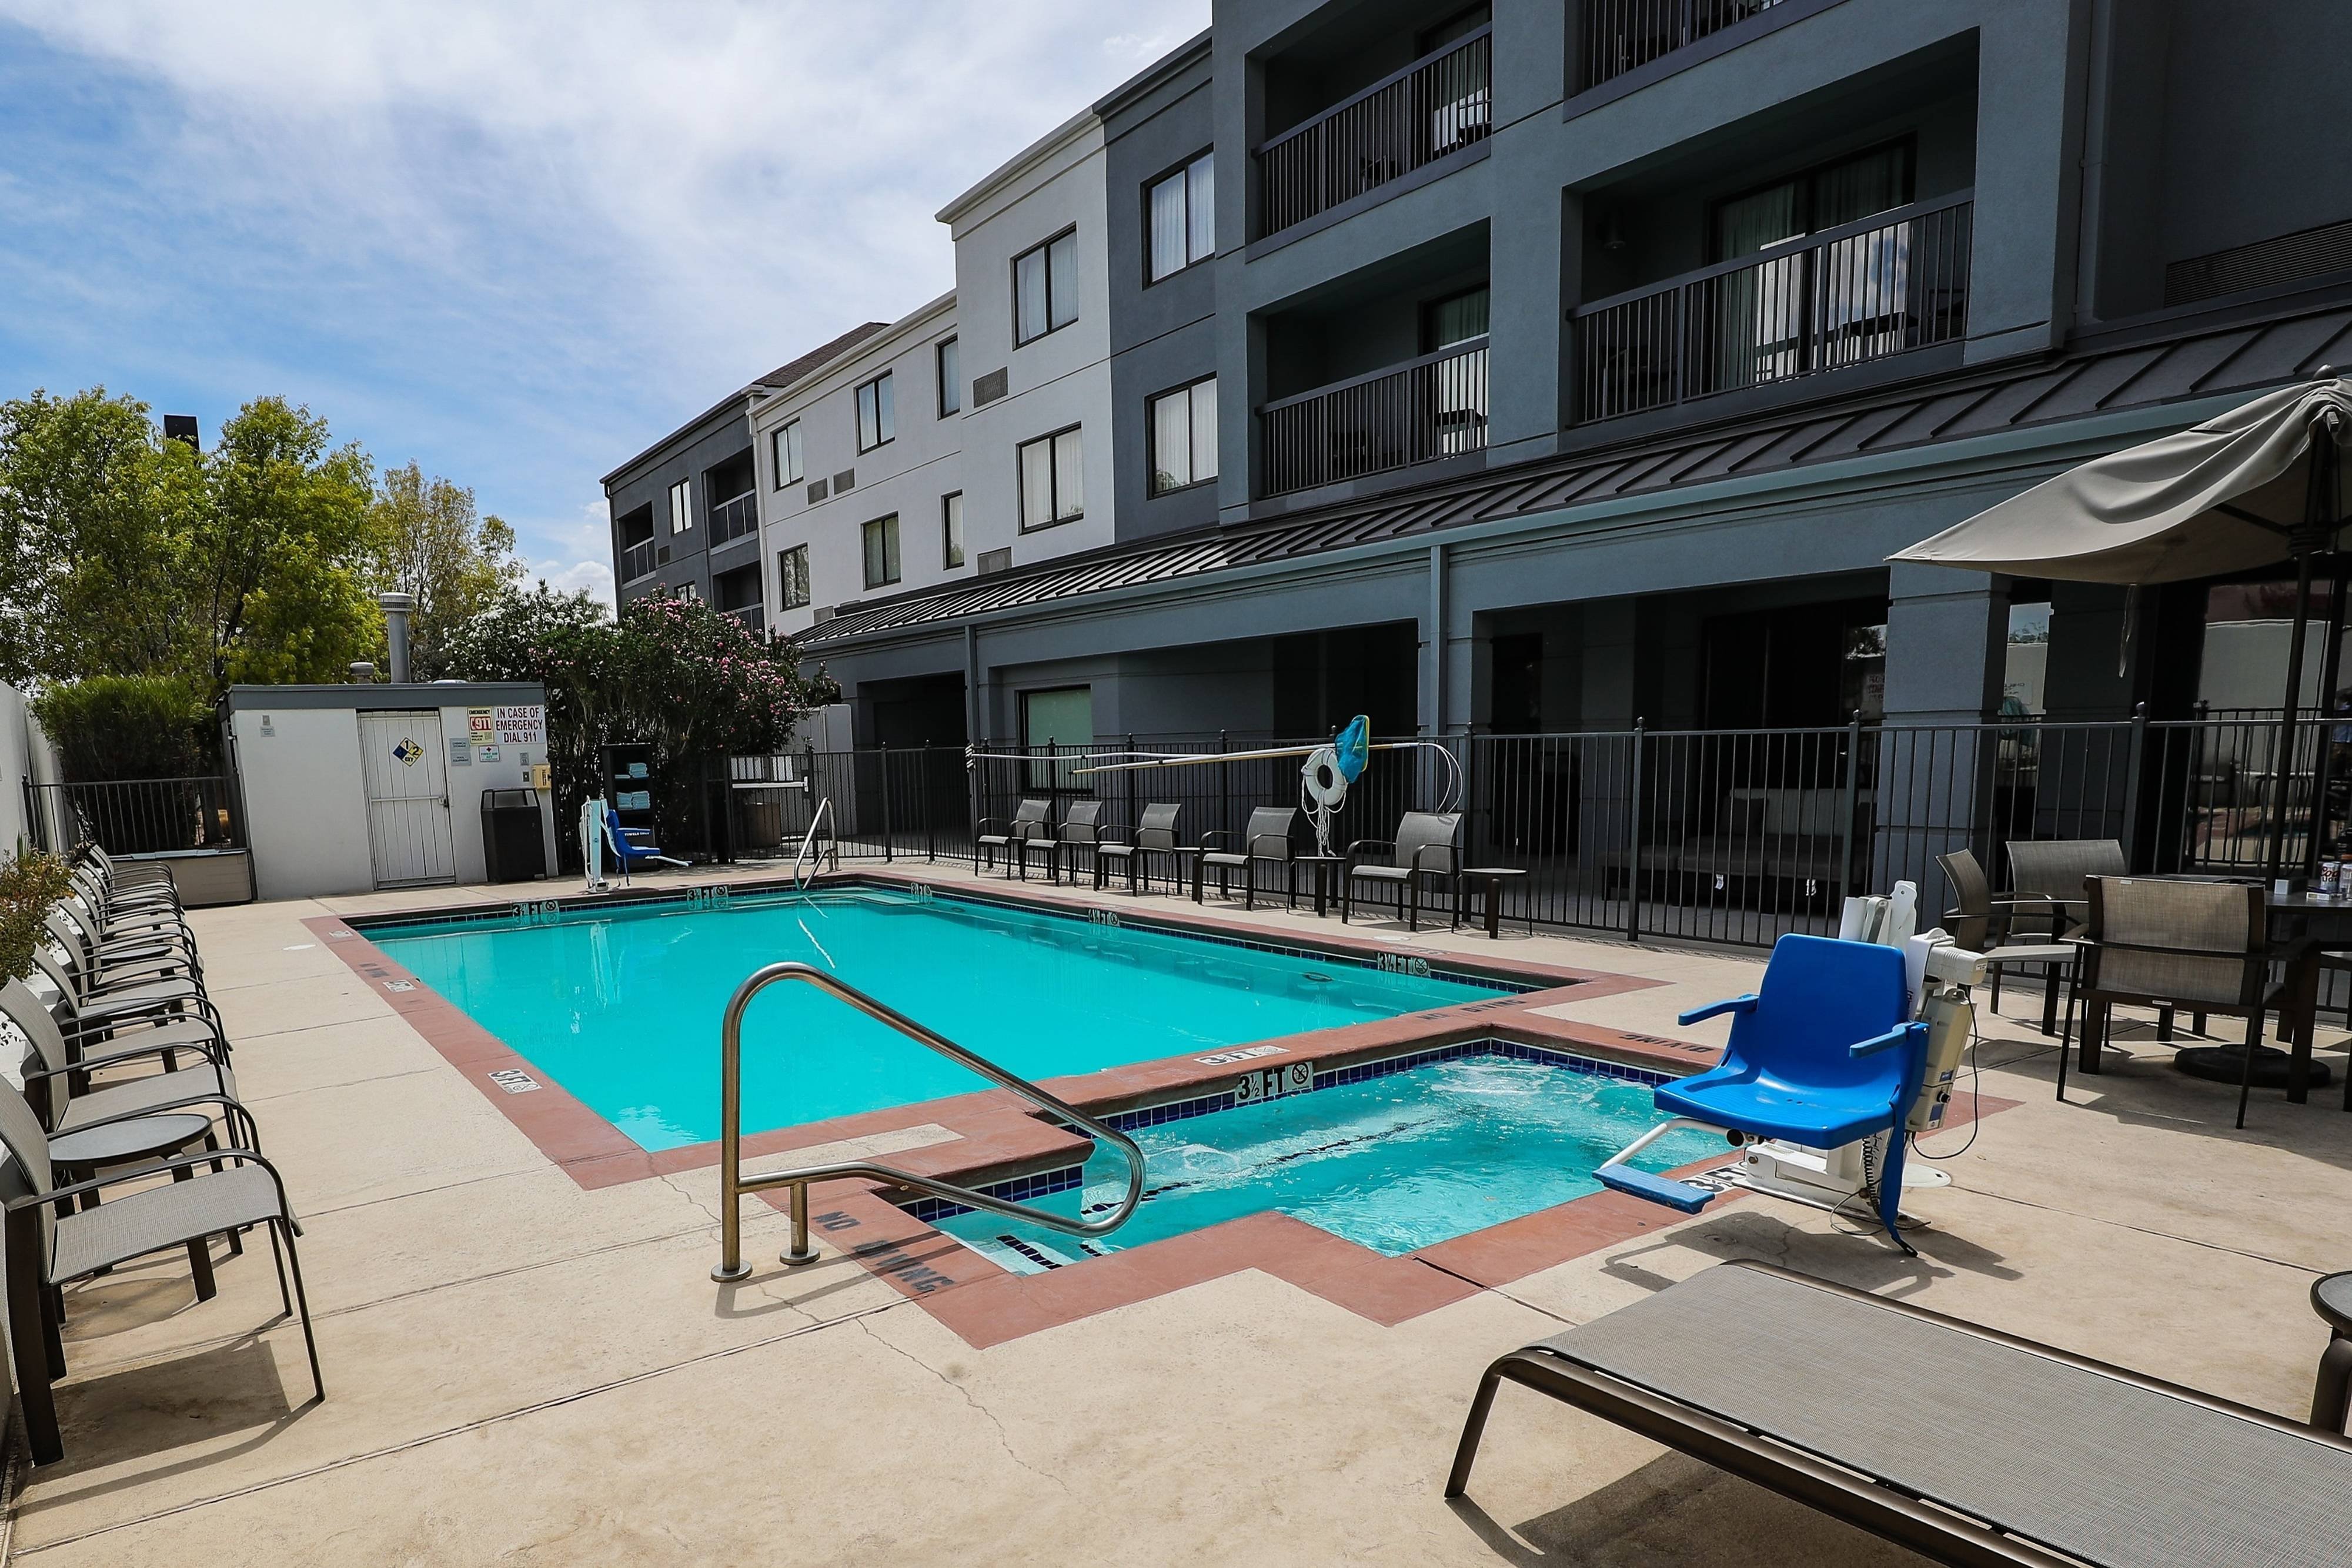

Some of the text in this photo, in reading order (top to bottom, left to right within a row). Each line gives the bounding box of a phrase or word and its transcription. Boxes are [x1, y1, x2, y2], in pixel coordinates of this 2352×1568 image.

[497, 707, 539, 718] IN CASE OF
[475, 717, 492, 730] 911
[496, 719, 543, 731] EMERGENCY
[504, 731, 536, 743] DIAL 911
[405, 740, 409, 750] 1
[412, 746, 419, 755] 2
[1618, 1034, 1715, 1053] DIVING
[811, 1211, 861, 1231] NO
[851, 1239, 955, 1292] DIVING
